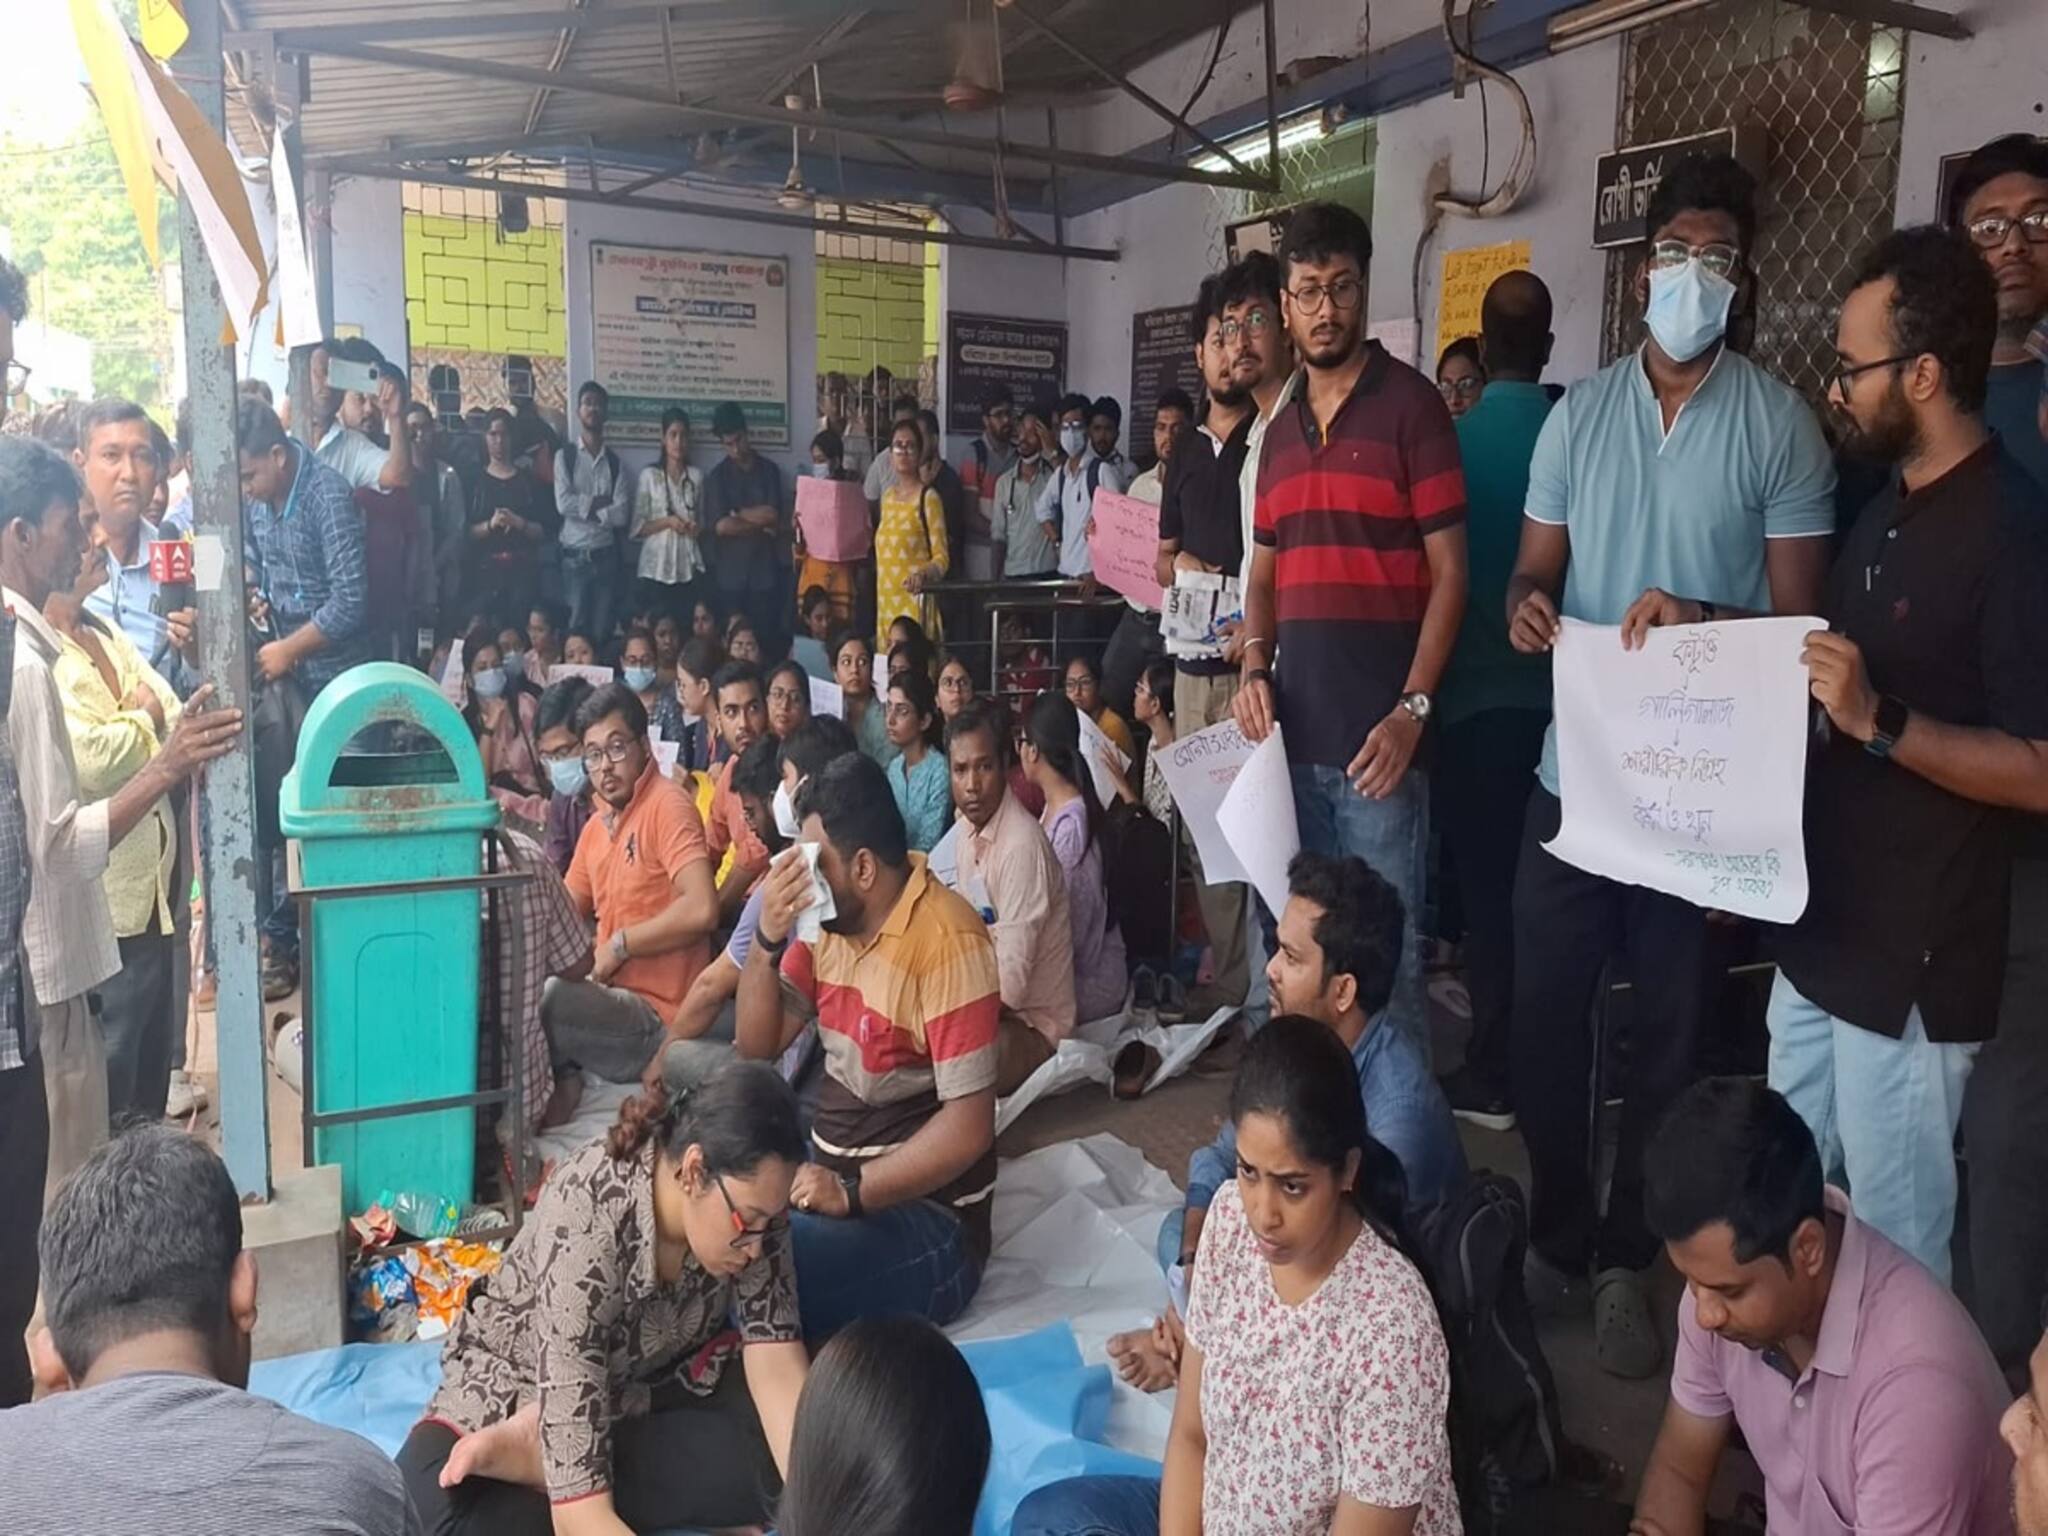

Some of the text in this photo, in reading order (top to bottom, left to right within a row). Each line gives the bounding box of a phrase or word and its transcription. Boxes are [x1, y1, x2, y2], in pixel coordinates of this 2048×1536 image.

[1600, 154, 1663, 226] রোগী ভর্ি
[1639, 688, 1736, 728] গালিগালাজ
[1666, 809, 1681, 832] ও
[1685, 808, 1715, 846] খুন
